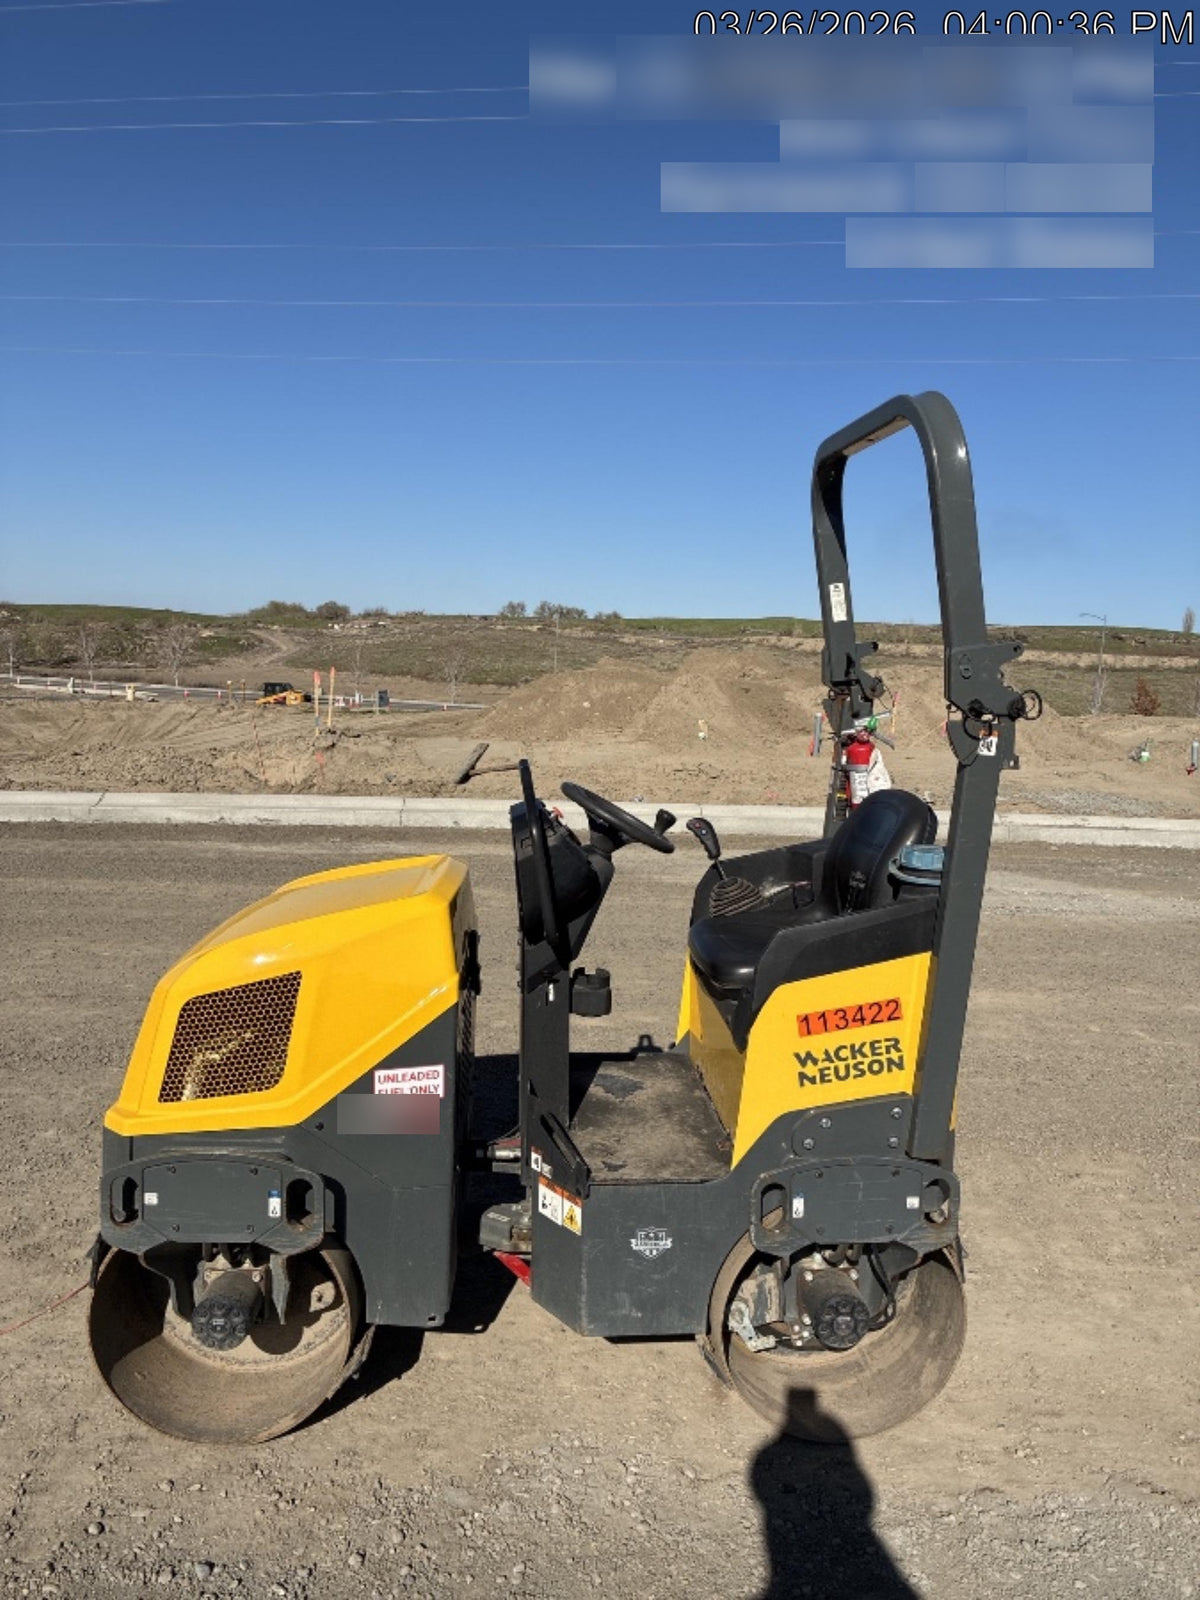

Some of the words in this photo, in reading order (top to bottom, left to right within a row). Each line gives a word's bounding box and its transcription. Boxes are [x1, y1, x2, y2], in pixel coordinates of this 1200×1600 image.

[800, 998, 902, 1035] 113422
[793, 1037, 903, 1068] WACKER
[377, 1069, 440, 1085] UNLEADED
[797, 1055, 905, 1087] NEUSON
[410, 1083, 440, 1094] ONLY
